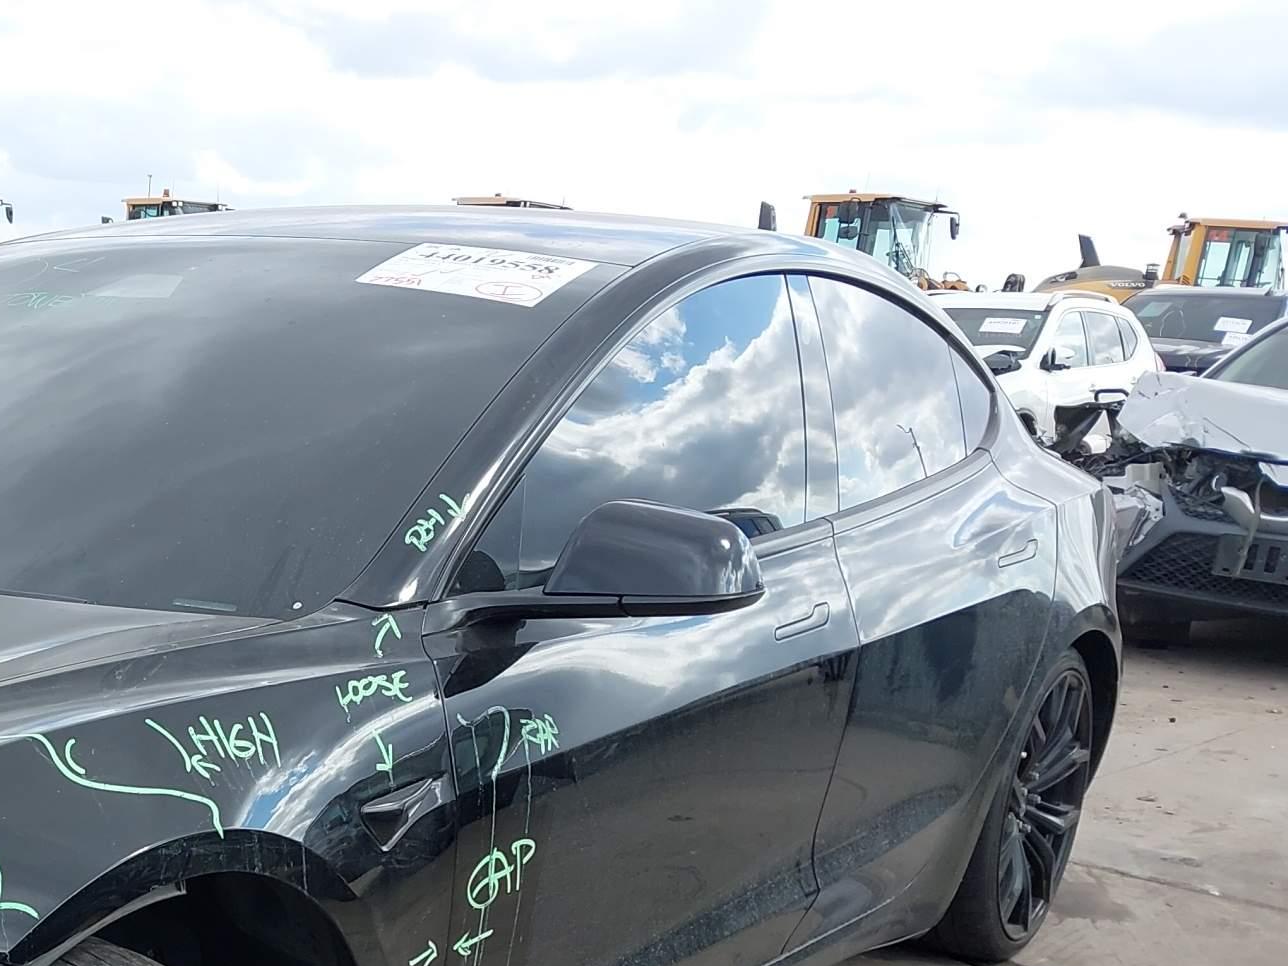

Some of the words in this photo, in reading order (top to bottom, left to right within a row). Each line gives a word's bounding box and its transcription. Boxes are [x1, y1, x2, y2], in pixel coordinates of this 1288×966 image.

[419, 250, 560, 275] 44019558
[335, 670, 413, 706] LOOSE
[188, 712, 282, 768] HIGH
[467, 838, 536, 909] GAP
